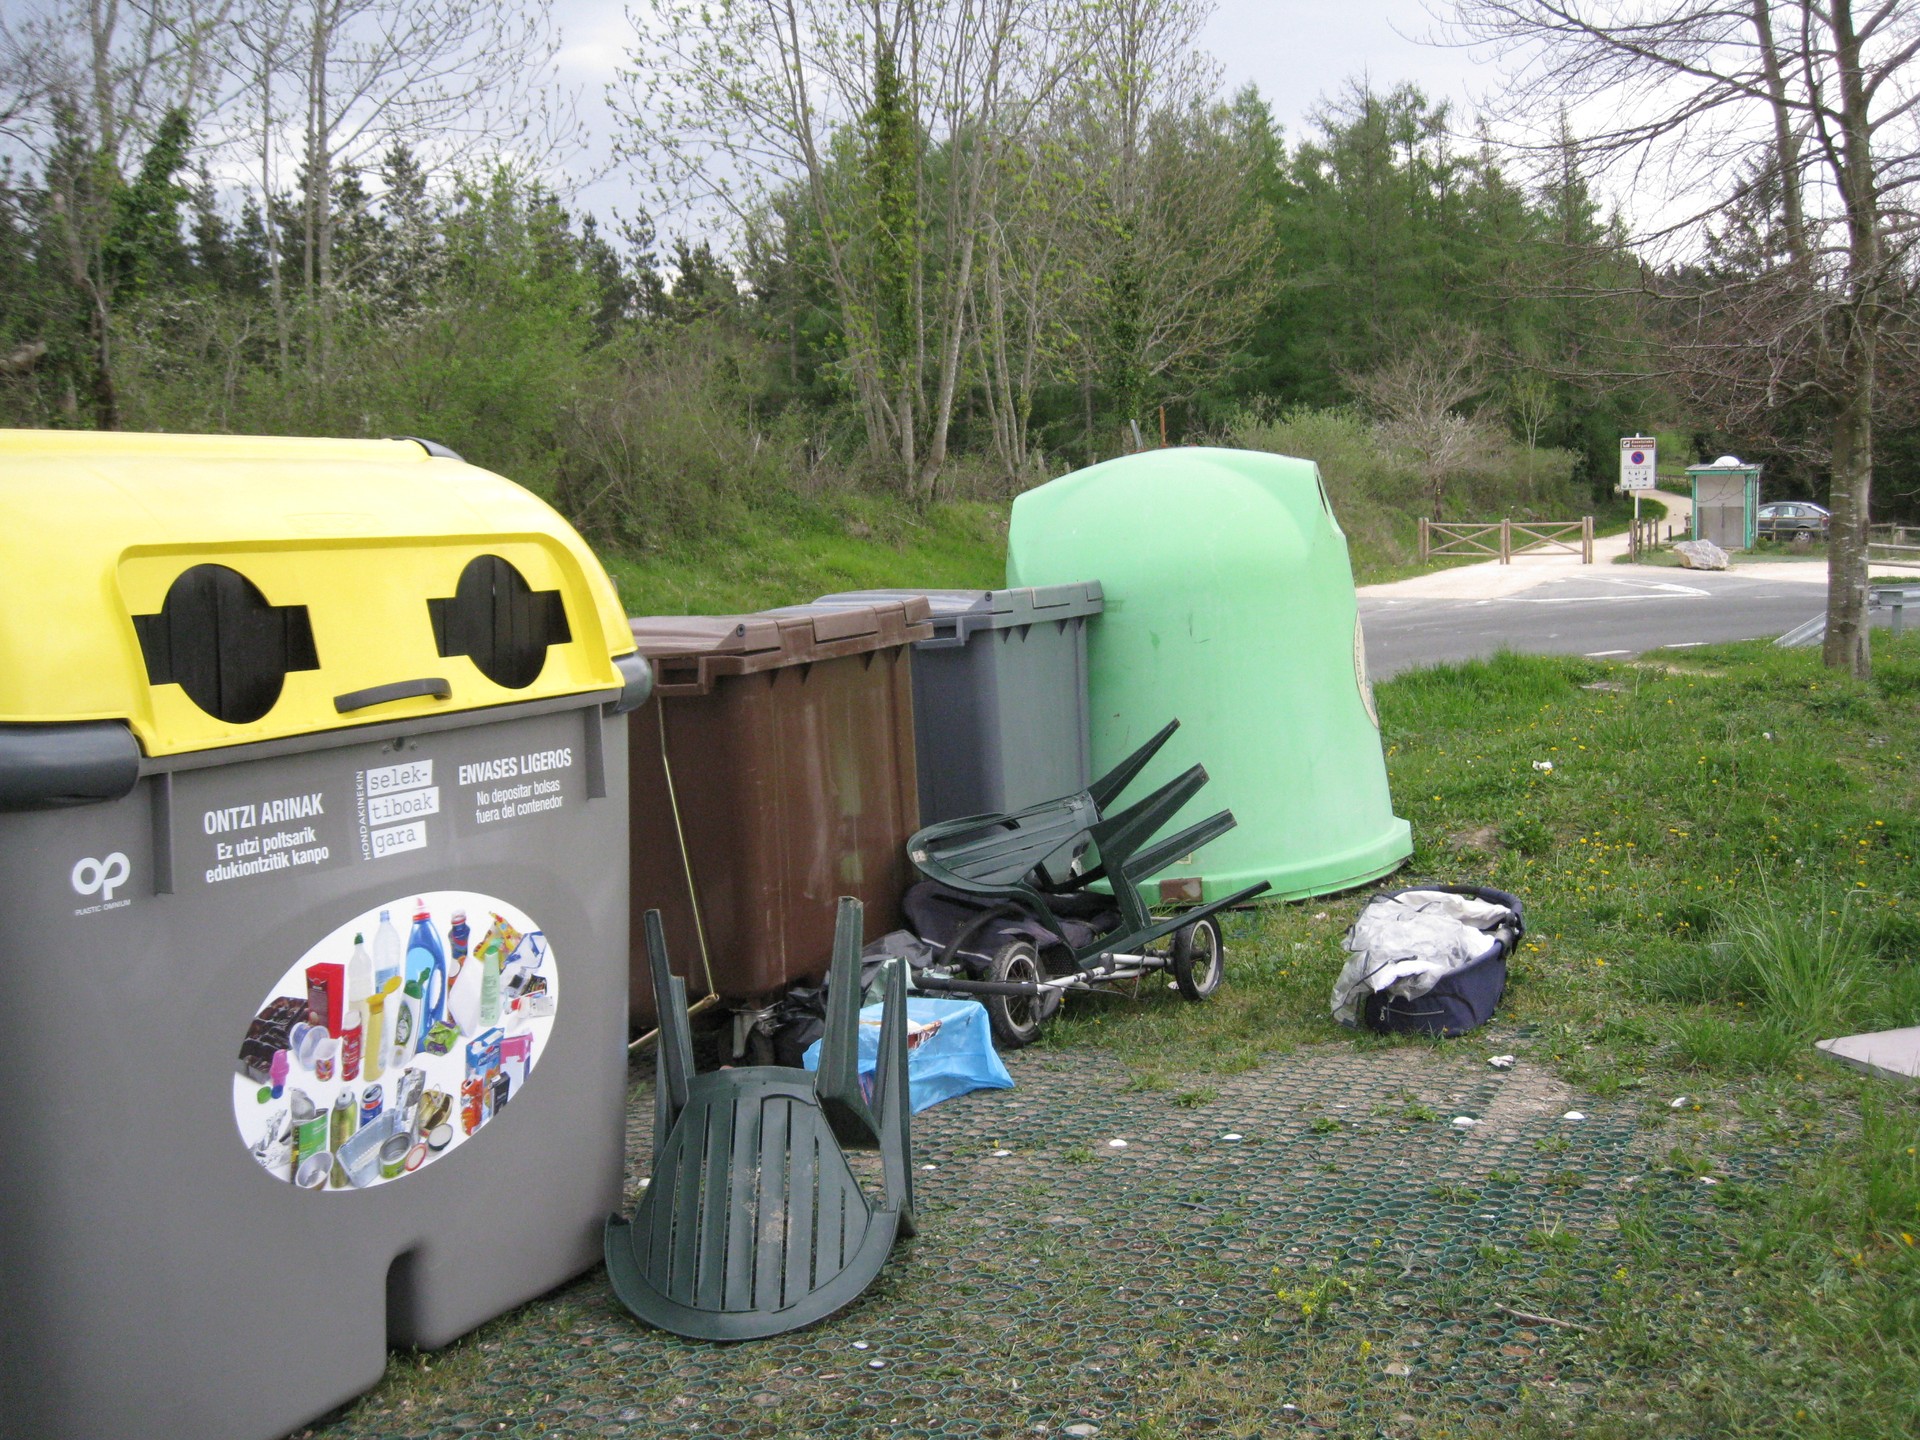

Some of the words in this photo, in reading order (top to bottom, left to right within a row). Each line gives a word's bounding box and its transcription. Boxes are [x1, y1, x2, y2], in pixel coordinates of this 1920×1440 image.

[370, 766, 428, 790] selek-
[459, 757, 518, 785] ENVASES
[521, 748, 572, 774] LIGEROS
[371, 793, 433, 819] tiboak
[477, 791, 490, 806] No
[492, 784, 532, 804] depositar
[534, 780, 560, 795] bolsas
[204, 804, 257, 834] ONTZI
[261, 793, 324, 825] ARINAK
[356, 770, 371, 860] HONDAKINEKIN
[476, 809, 501, 824] fuera
[502, 803, 516, 818] del
[517, 795, 563, 816] contenedor
[217, 843, 233, 860] Ez
[236, 836, 260, 856] utzi
[263, 826, 316, 855] poltsarik
[375, 828, 417, 853] gara
[206, 852, 290, 883] edukiontzitik
[292, 846, 330, 864] kanpo
